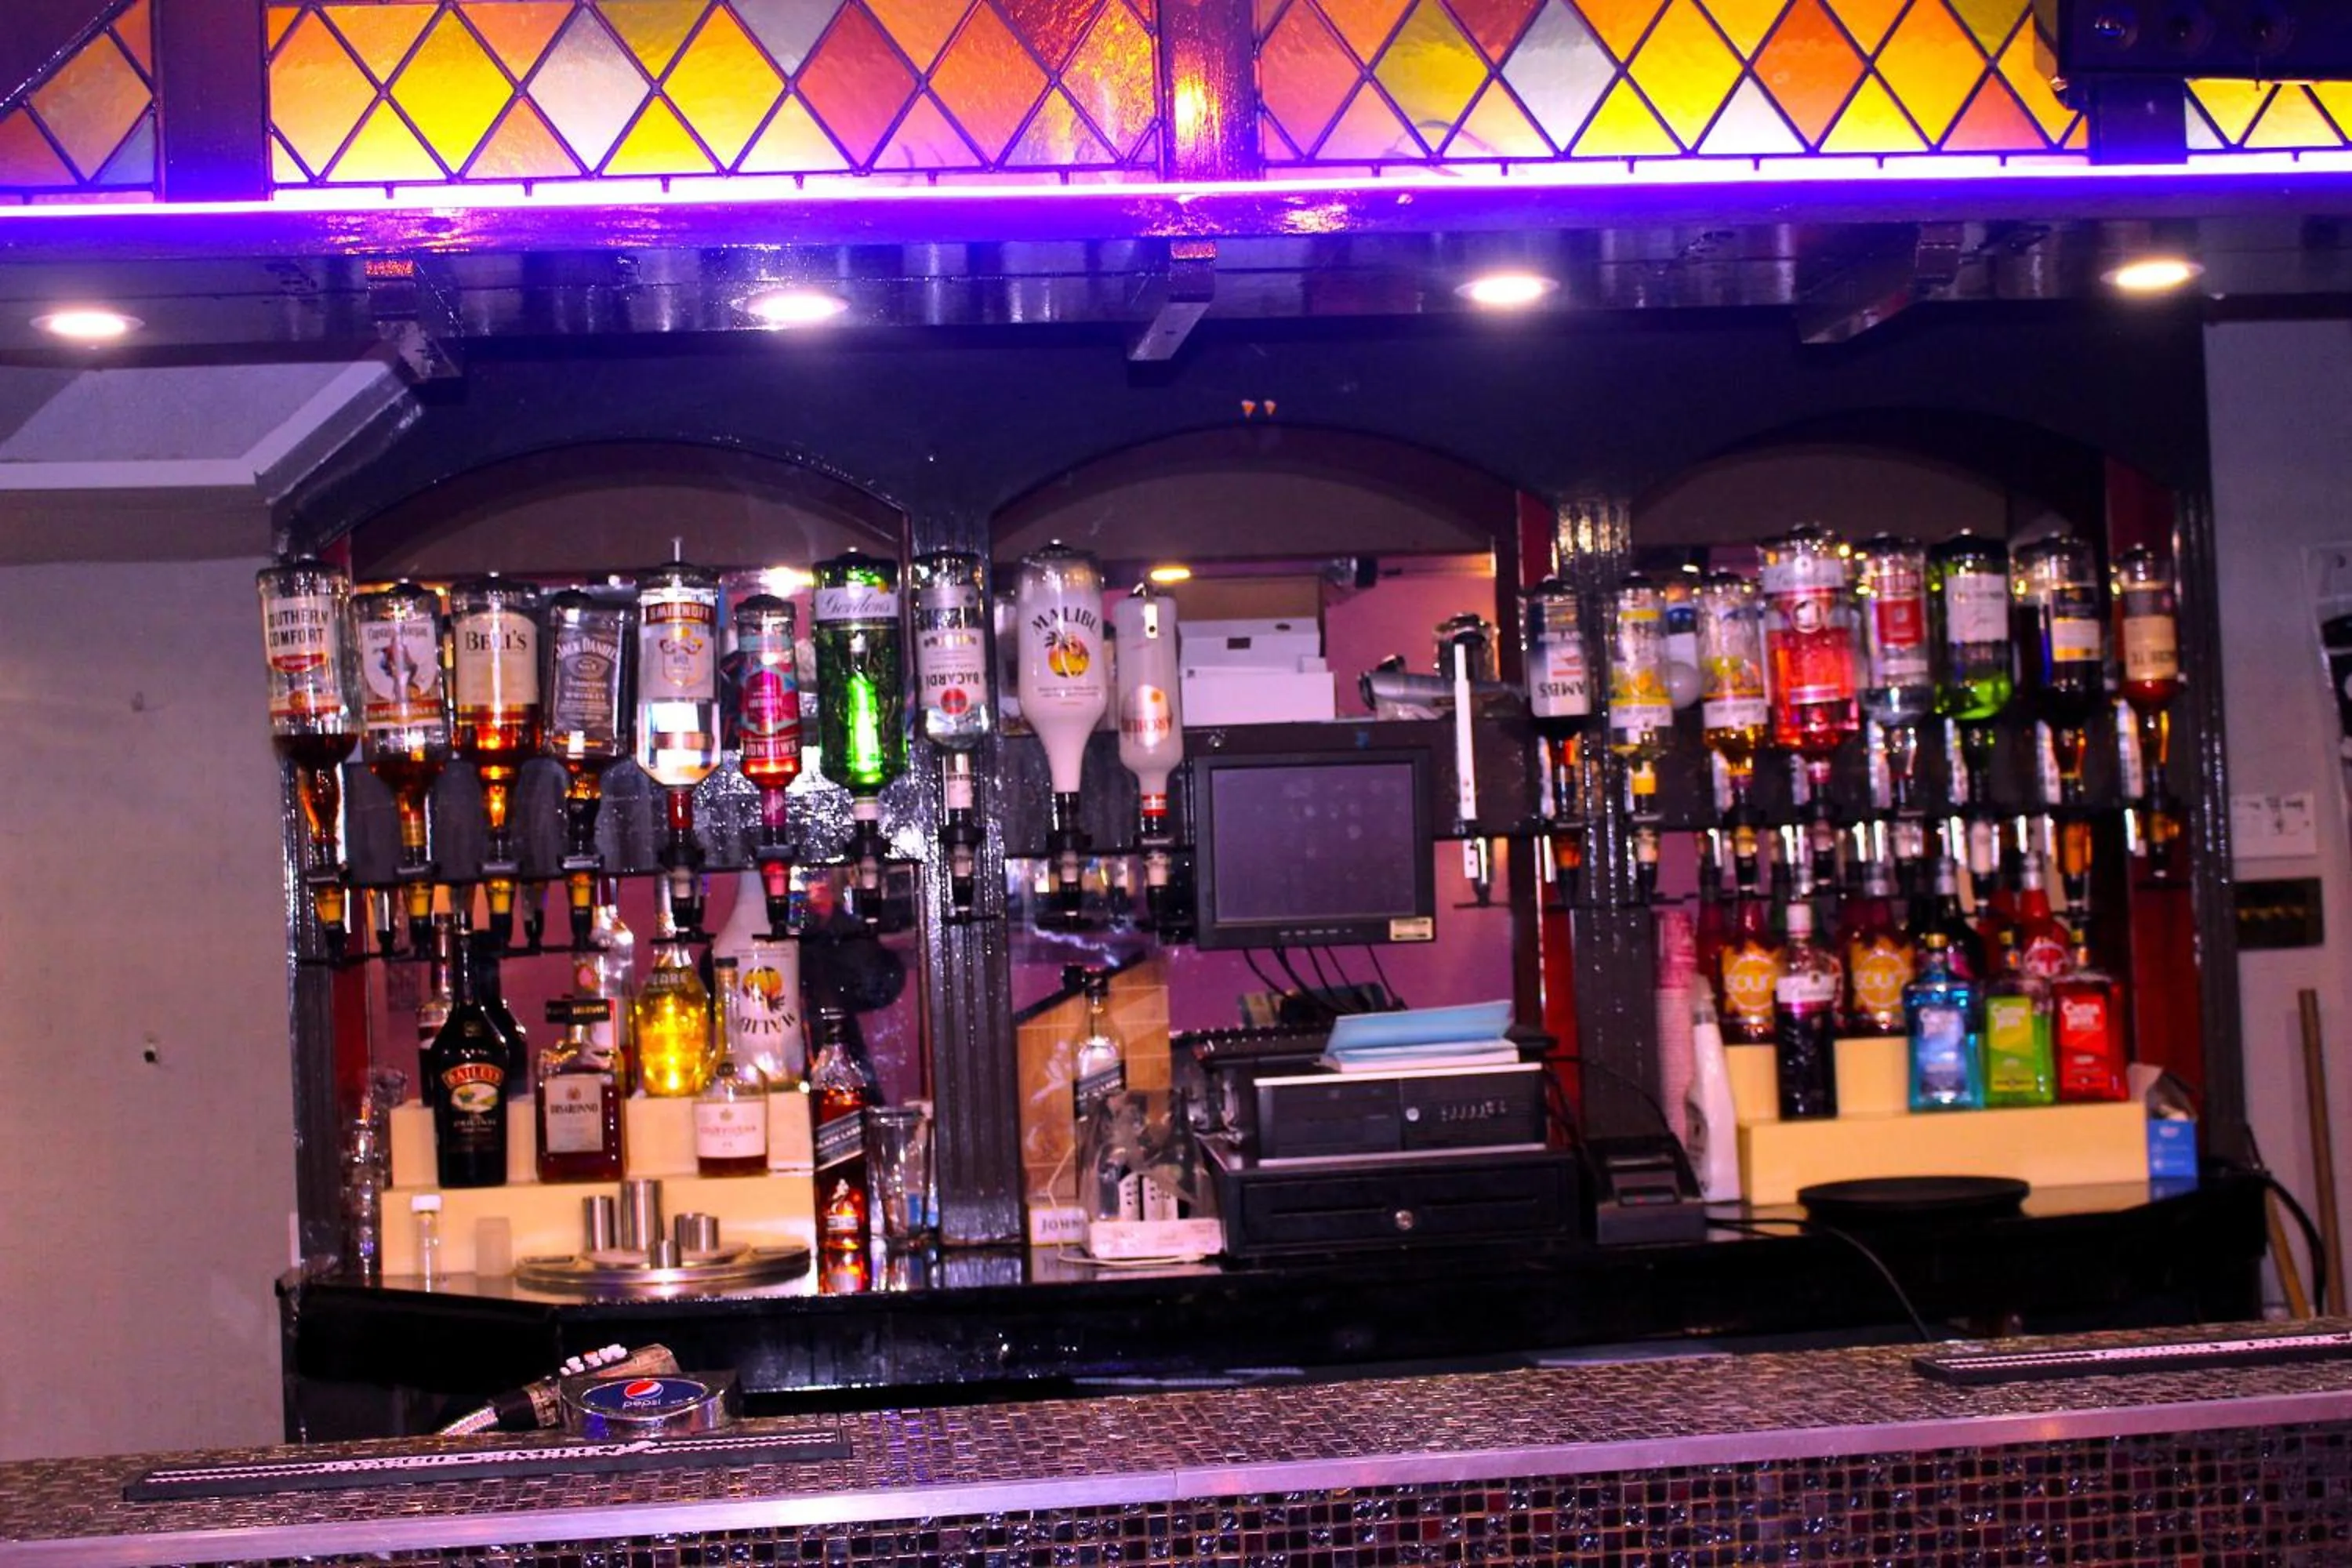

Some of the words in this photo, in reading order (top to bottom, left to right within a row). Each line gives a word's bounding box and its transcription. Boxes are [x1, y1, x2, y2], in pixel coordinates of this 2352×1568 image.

[268, 609, 329, 628] OUTHERN
[649, 601, 710, 620] SMINOFF
[269, 628, 325, 648] COMFORT
[466, 629, 528, 651] BEL'S
[926, 671, 980, 690] BACARDI
[740, 1013, 796, 1034] MALIB
[622, 1399, 661, 1410] pepsi
